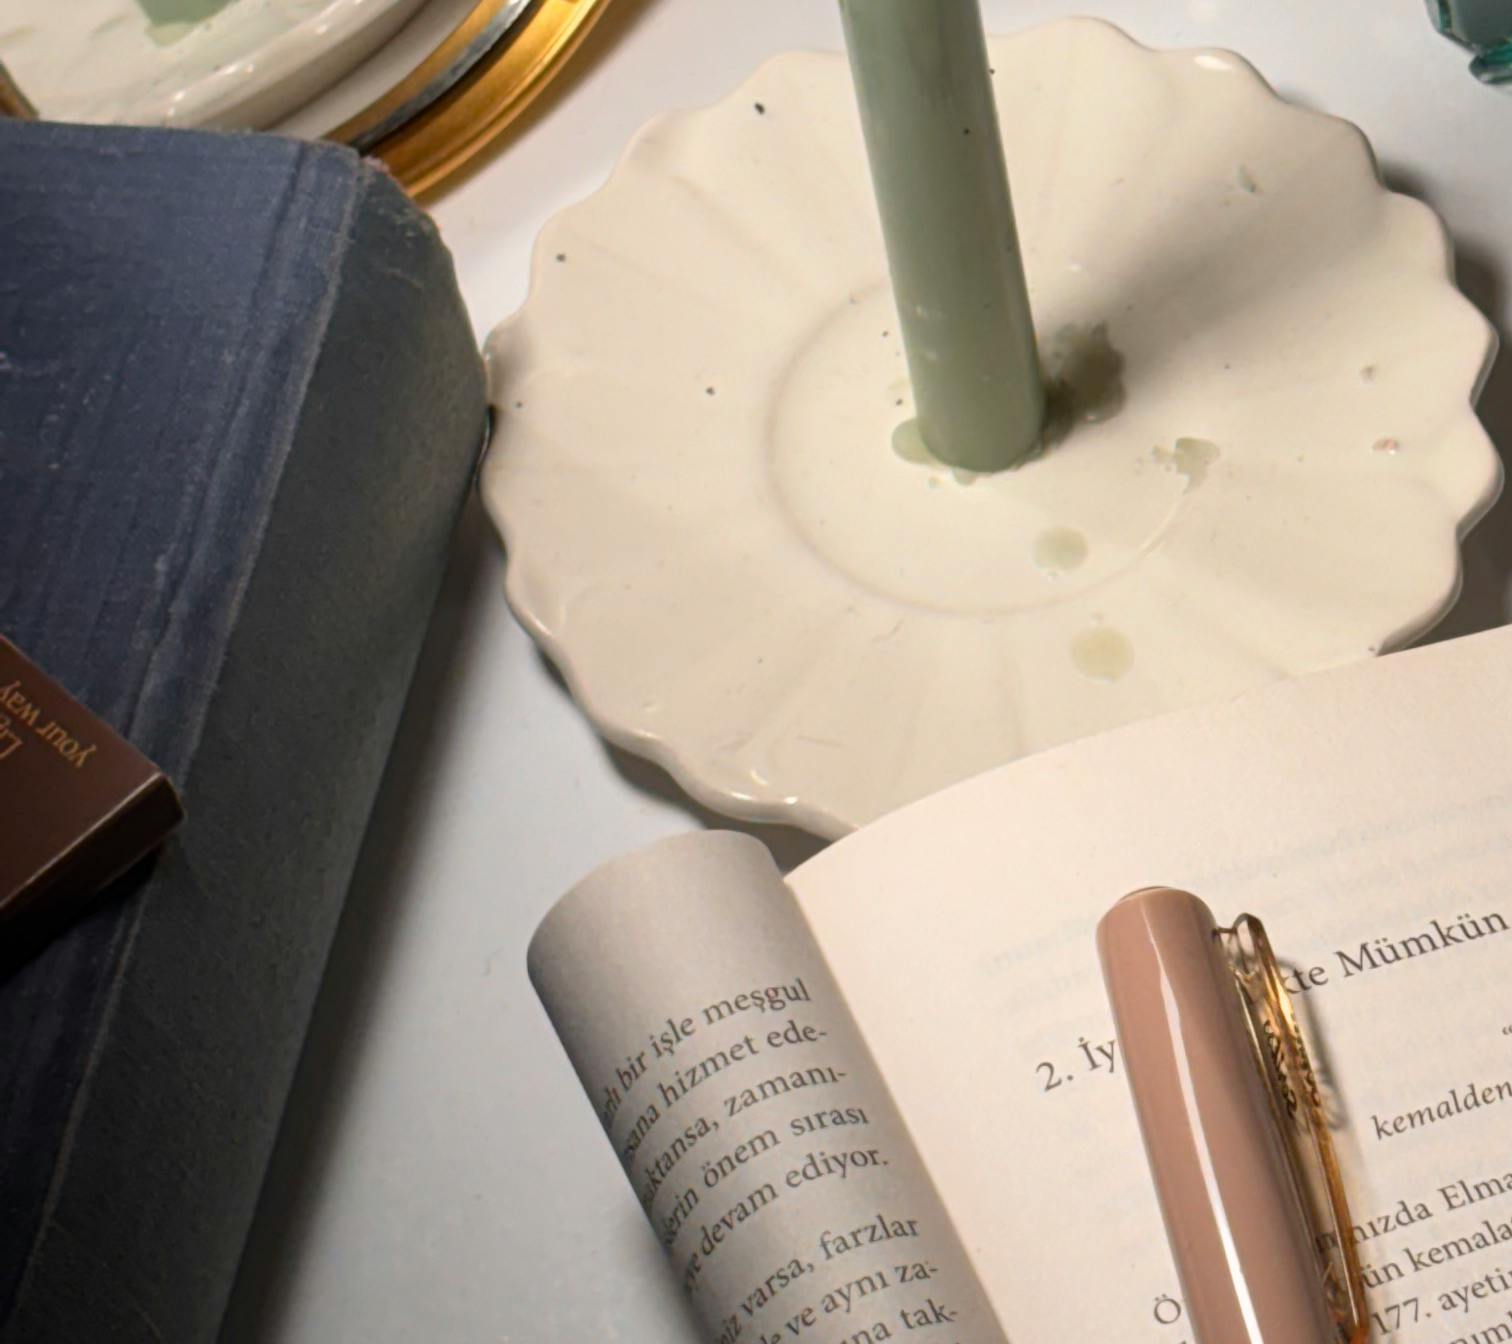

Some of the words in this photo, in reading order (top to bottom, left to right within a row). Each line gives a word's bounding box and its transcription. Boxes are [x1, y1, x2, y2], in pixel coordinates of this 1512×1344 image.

[36, 721, 97, 768] your
[615, 1050, 649, 1093] bir
[650, 1016, 697, 1058] işle
[702, 977, 811, 1026] meşgul
[1035, 1060, 1074, 1093] 2.
[1333, 911, 1511, 978] Mümkün
[657, 1034, 760, 1108] hizmet
[766, 1019, 828, 1049] ede-
[724, 1065, 847, 1118] zamanı-
[703, 1128, 782, 1189] önem
[790, 1107, 870, 1137] sırası
[700, 1182, 780, 1258] devam
[785, 1147, 889, 1189] ediyor.
[740, 1258, 815, 1319] varsa,
[819, 1214, 920, 1261] farzlar
[785, 1307, 817, 1337] ve
[823, 1269, 890, 1316] aynı
[898, 1260, 939, 1285] za-
[900, 1298, 959, 1331] tak-
[1372, 1297, 1432, 1337] 177.
